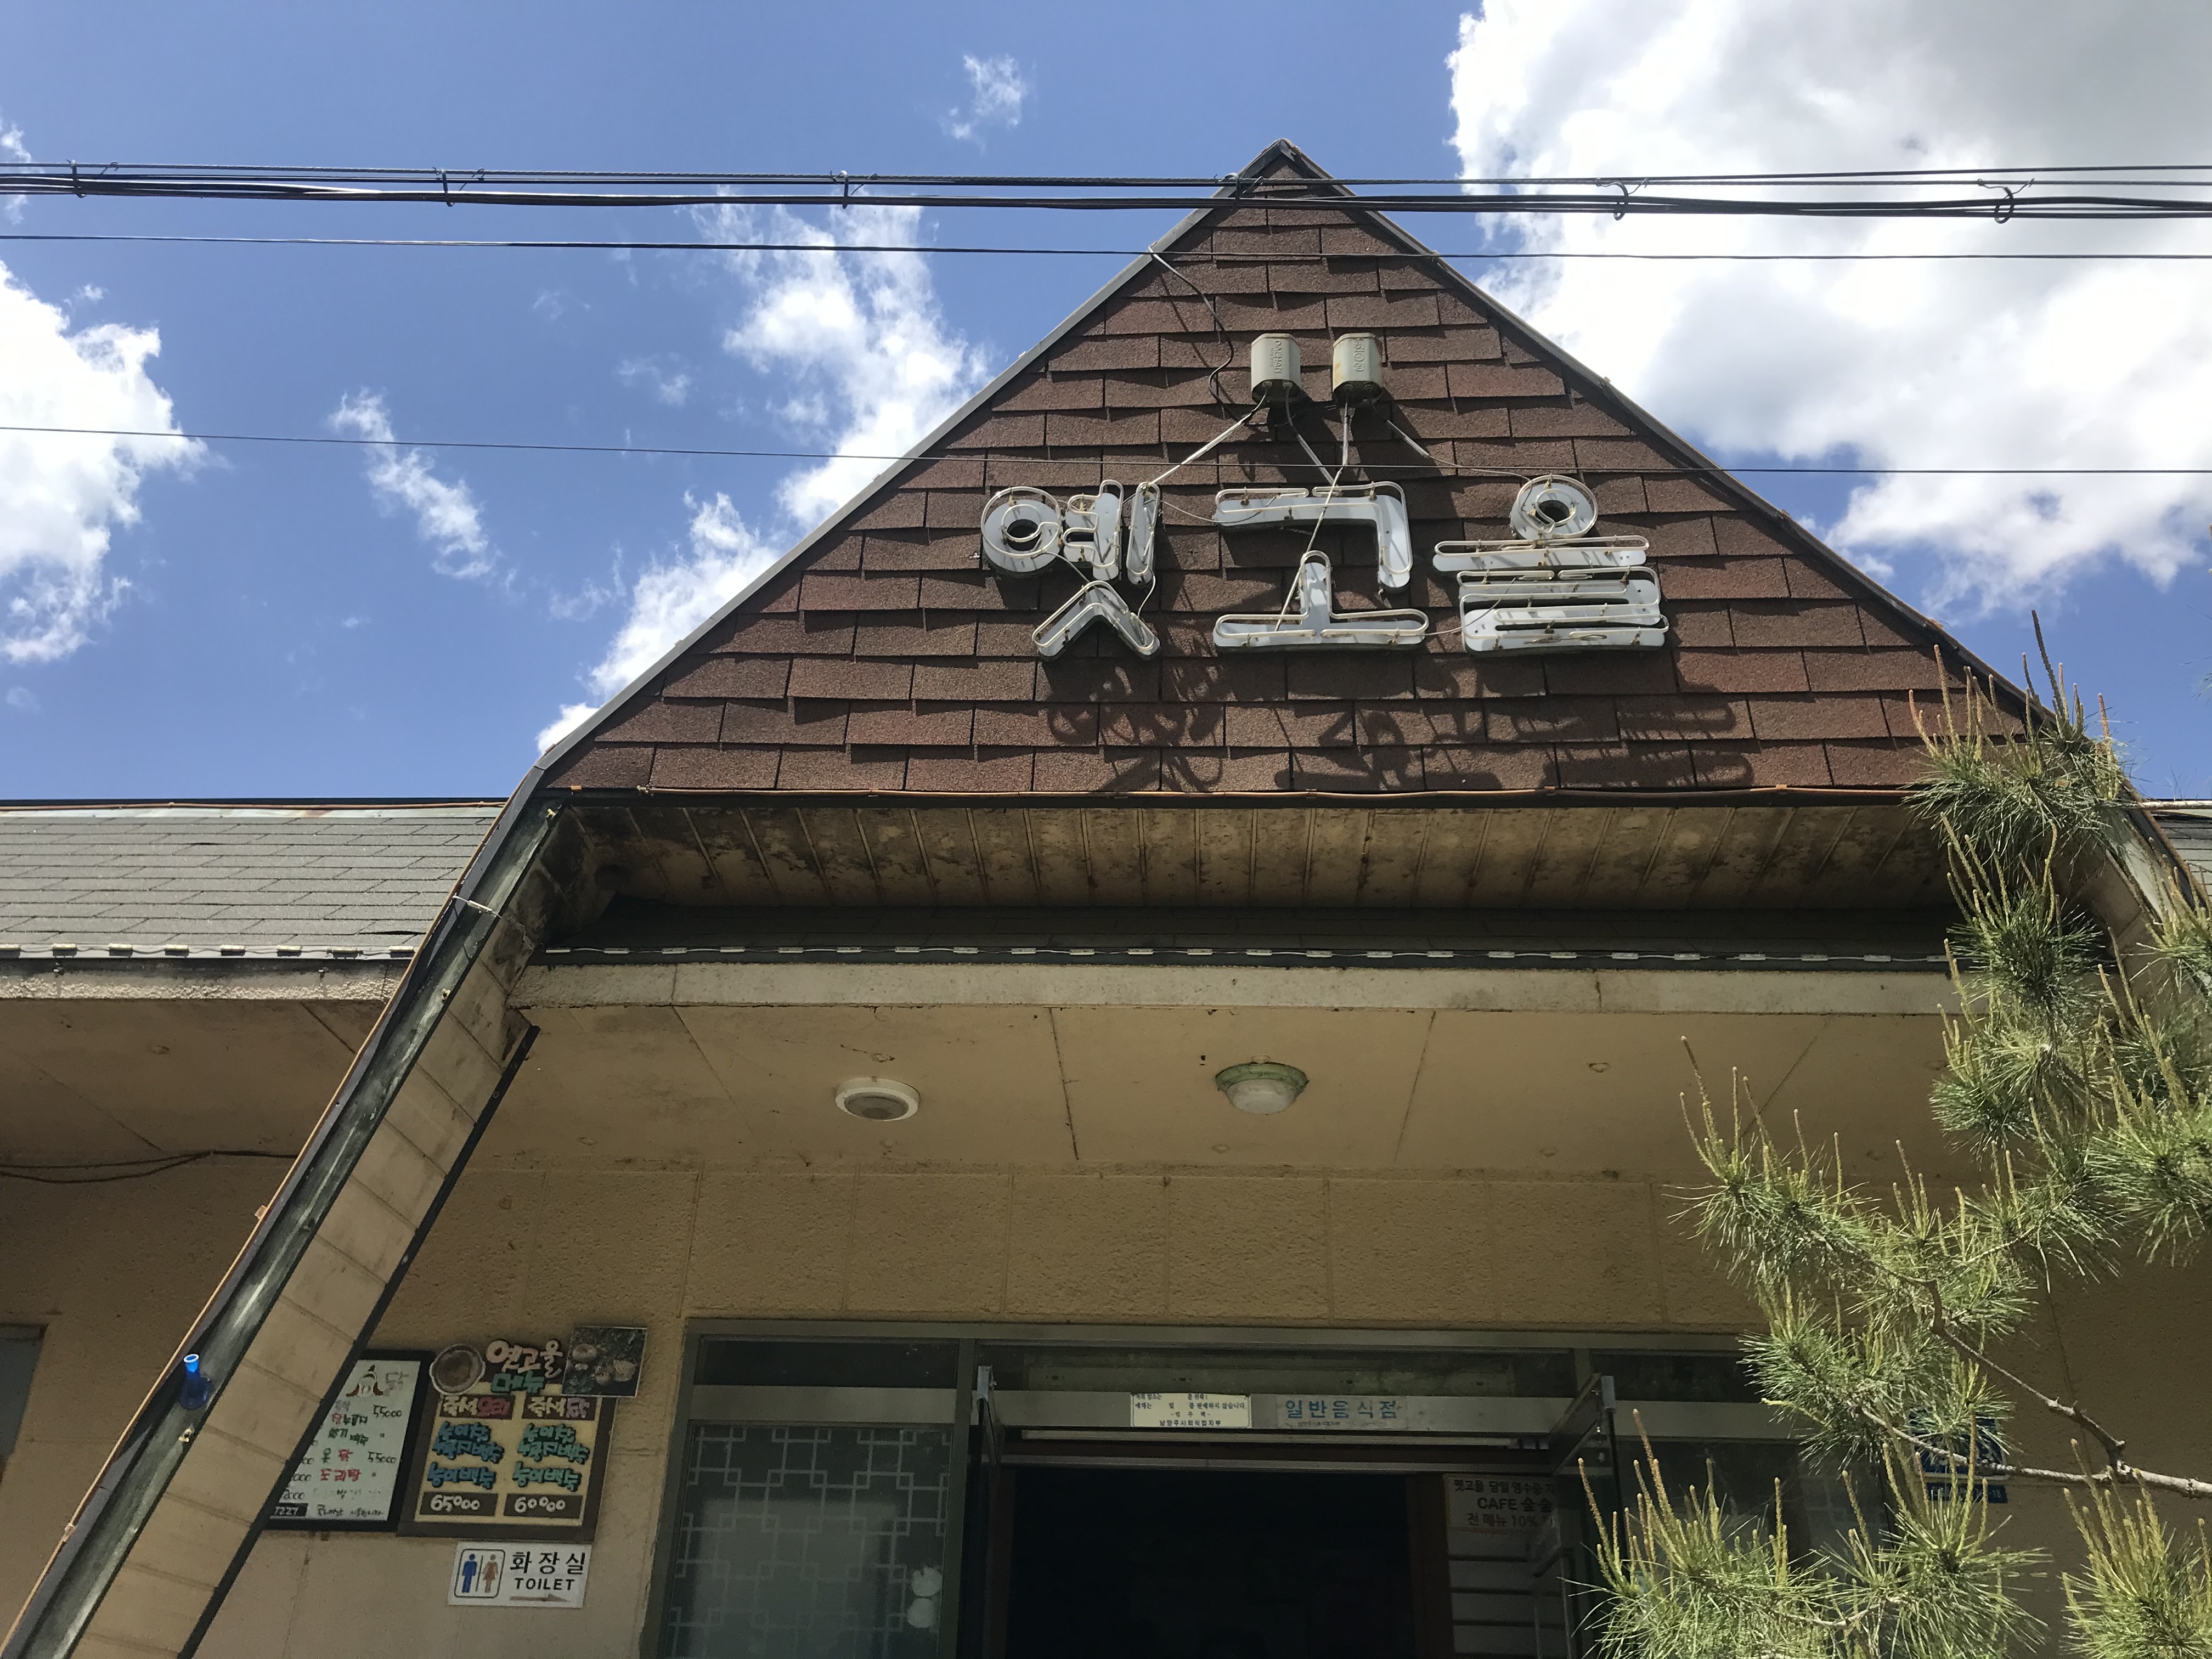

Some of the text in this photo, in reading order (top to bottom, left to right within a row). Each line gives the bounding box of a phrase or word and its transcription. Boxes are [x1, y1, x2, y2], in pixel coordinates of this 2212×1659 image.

[1274, 339, 1283, 374] DAEHAN
[981, 473, 1669, 657] 옛고을
[490, 1369, 545, 1394] 메뉴
[1285, 1400, 1397, 1419] 일반음식점
[431, 1494, 480, 1512] 65000
[514, 1496, 566, 1513] 60000
[1477, 1497, 1517, 1510] CAFE
[510, 1551, 585, 1575] 화장실
[515, 1577, 575, 1590] TOILET
